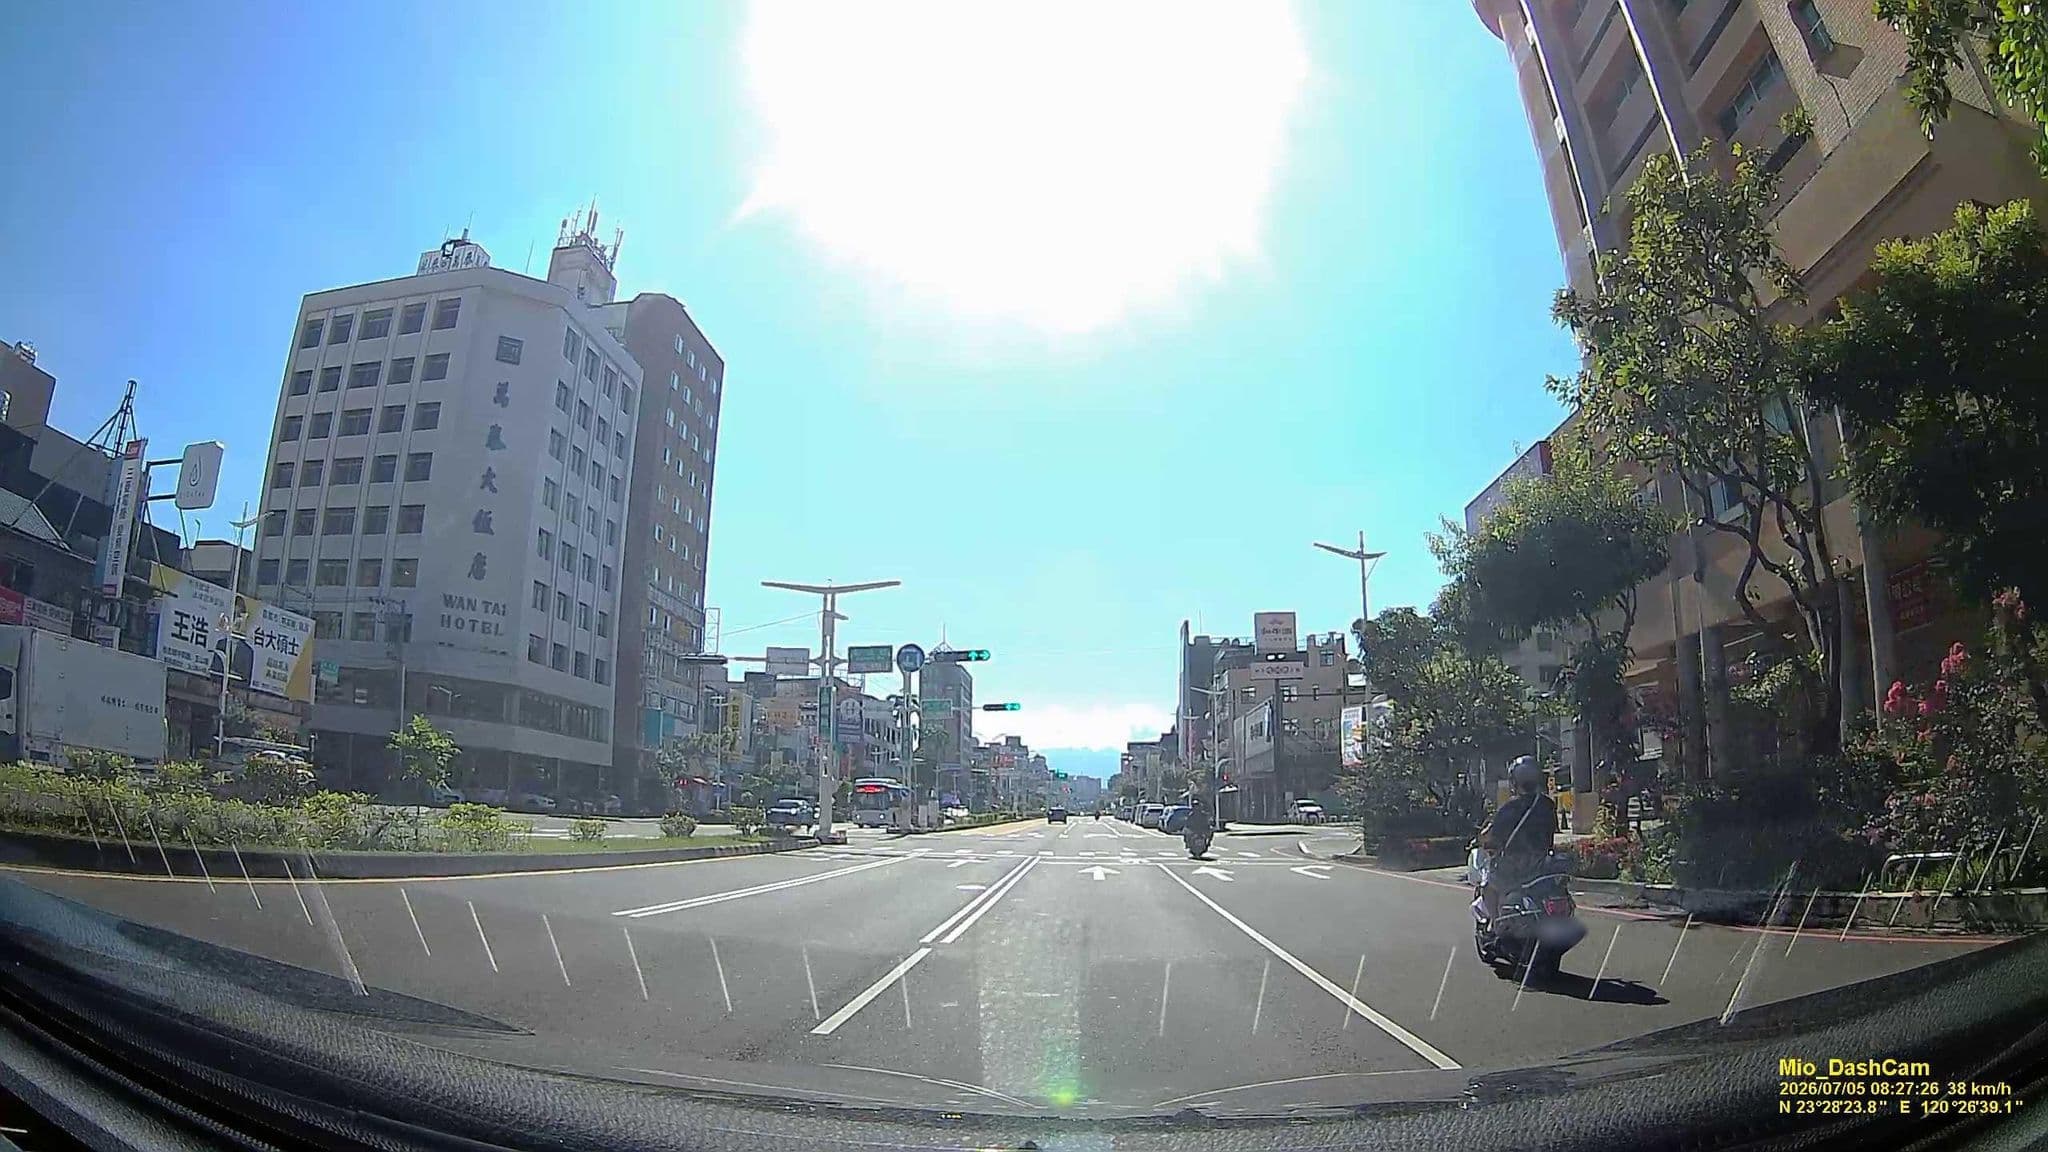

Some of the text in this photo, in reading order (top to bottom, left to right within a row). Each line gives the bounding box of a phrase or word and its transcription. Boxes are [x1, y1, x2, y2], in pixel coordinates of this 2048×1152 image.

[441, 592, 507, 617] WAN TAI
[170, 610, 209, 649] 王浩
[440, 613, 504, 637] HOTEL
[253, 626, 300, 657] 台大碩士
